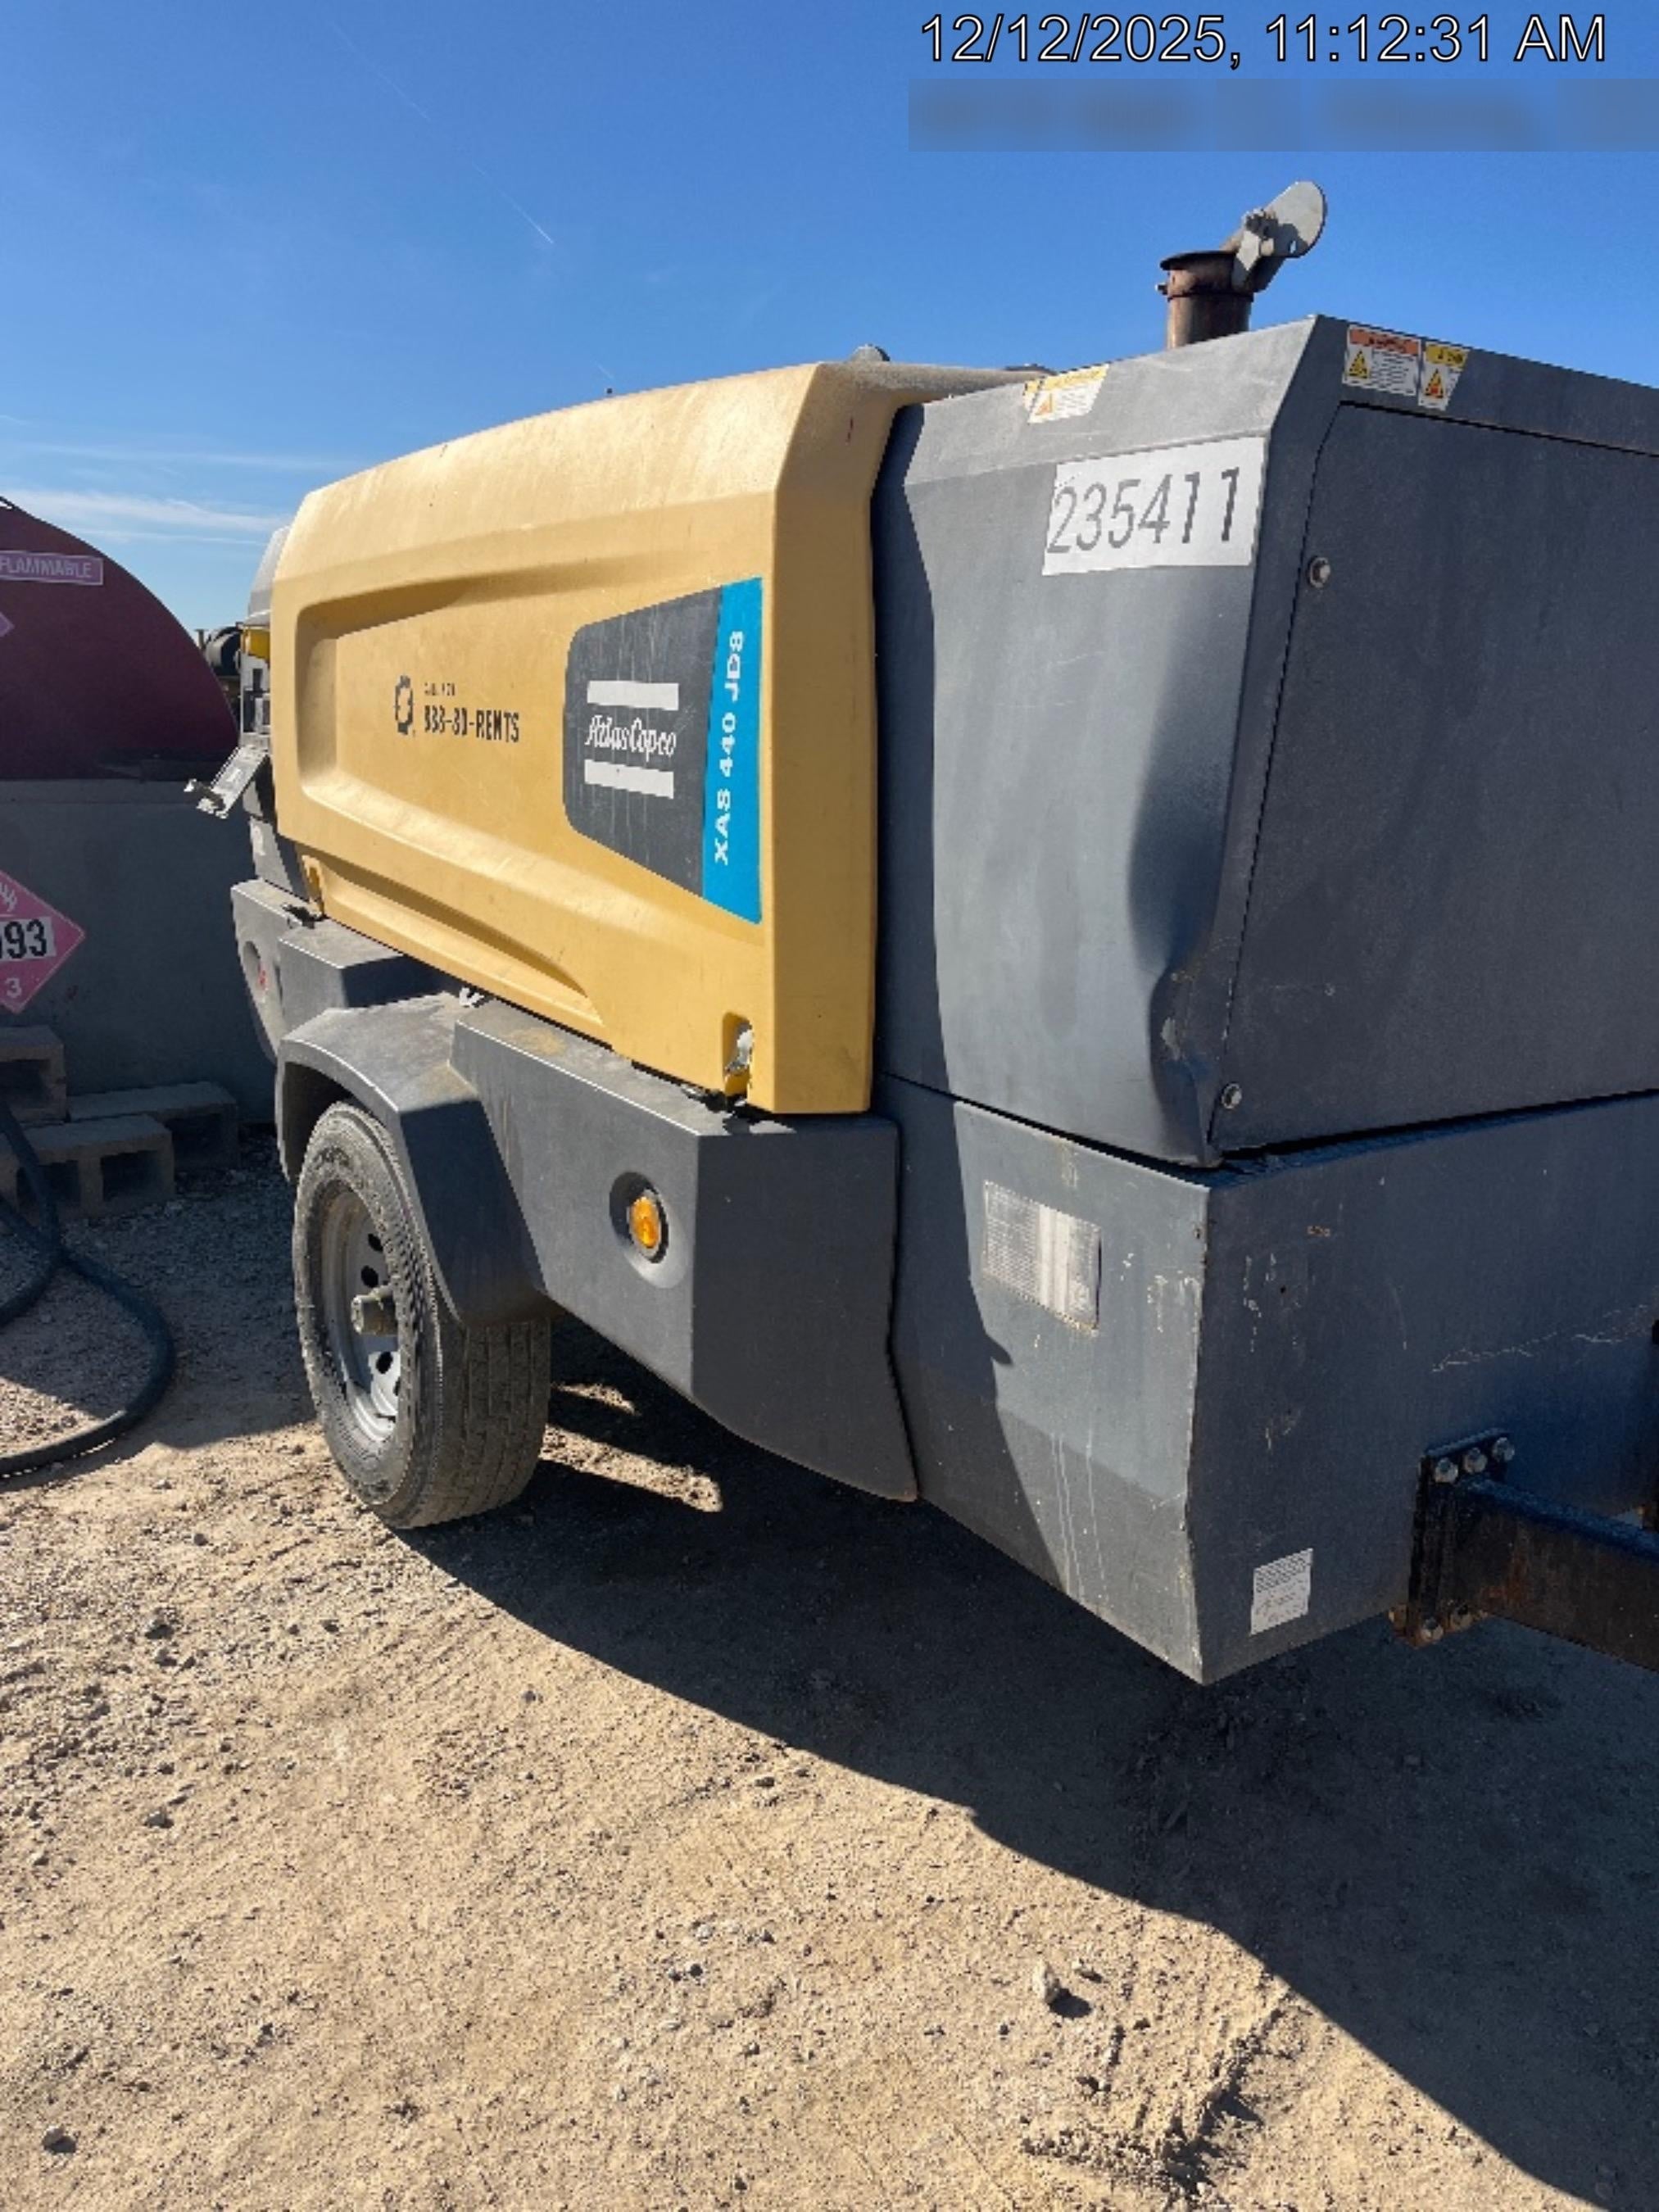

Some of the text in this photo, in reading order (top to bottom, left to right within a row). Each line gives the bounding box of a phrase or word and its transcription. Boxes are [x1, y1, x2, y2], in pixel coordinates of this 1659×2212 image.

[1047, 467, 1240, 553] 235411
[0, 557, 93, 578] FLAMMABLE
[718, 711, 737, 777] 440
[714, 788, 732, 866] XAS
[6, 977, 23, 999] 3
